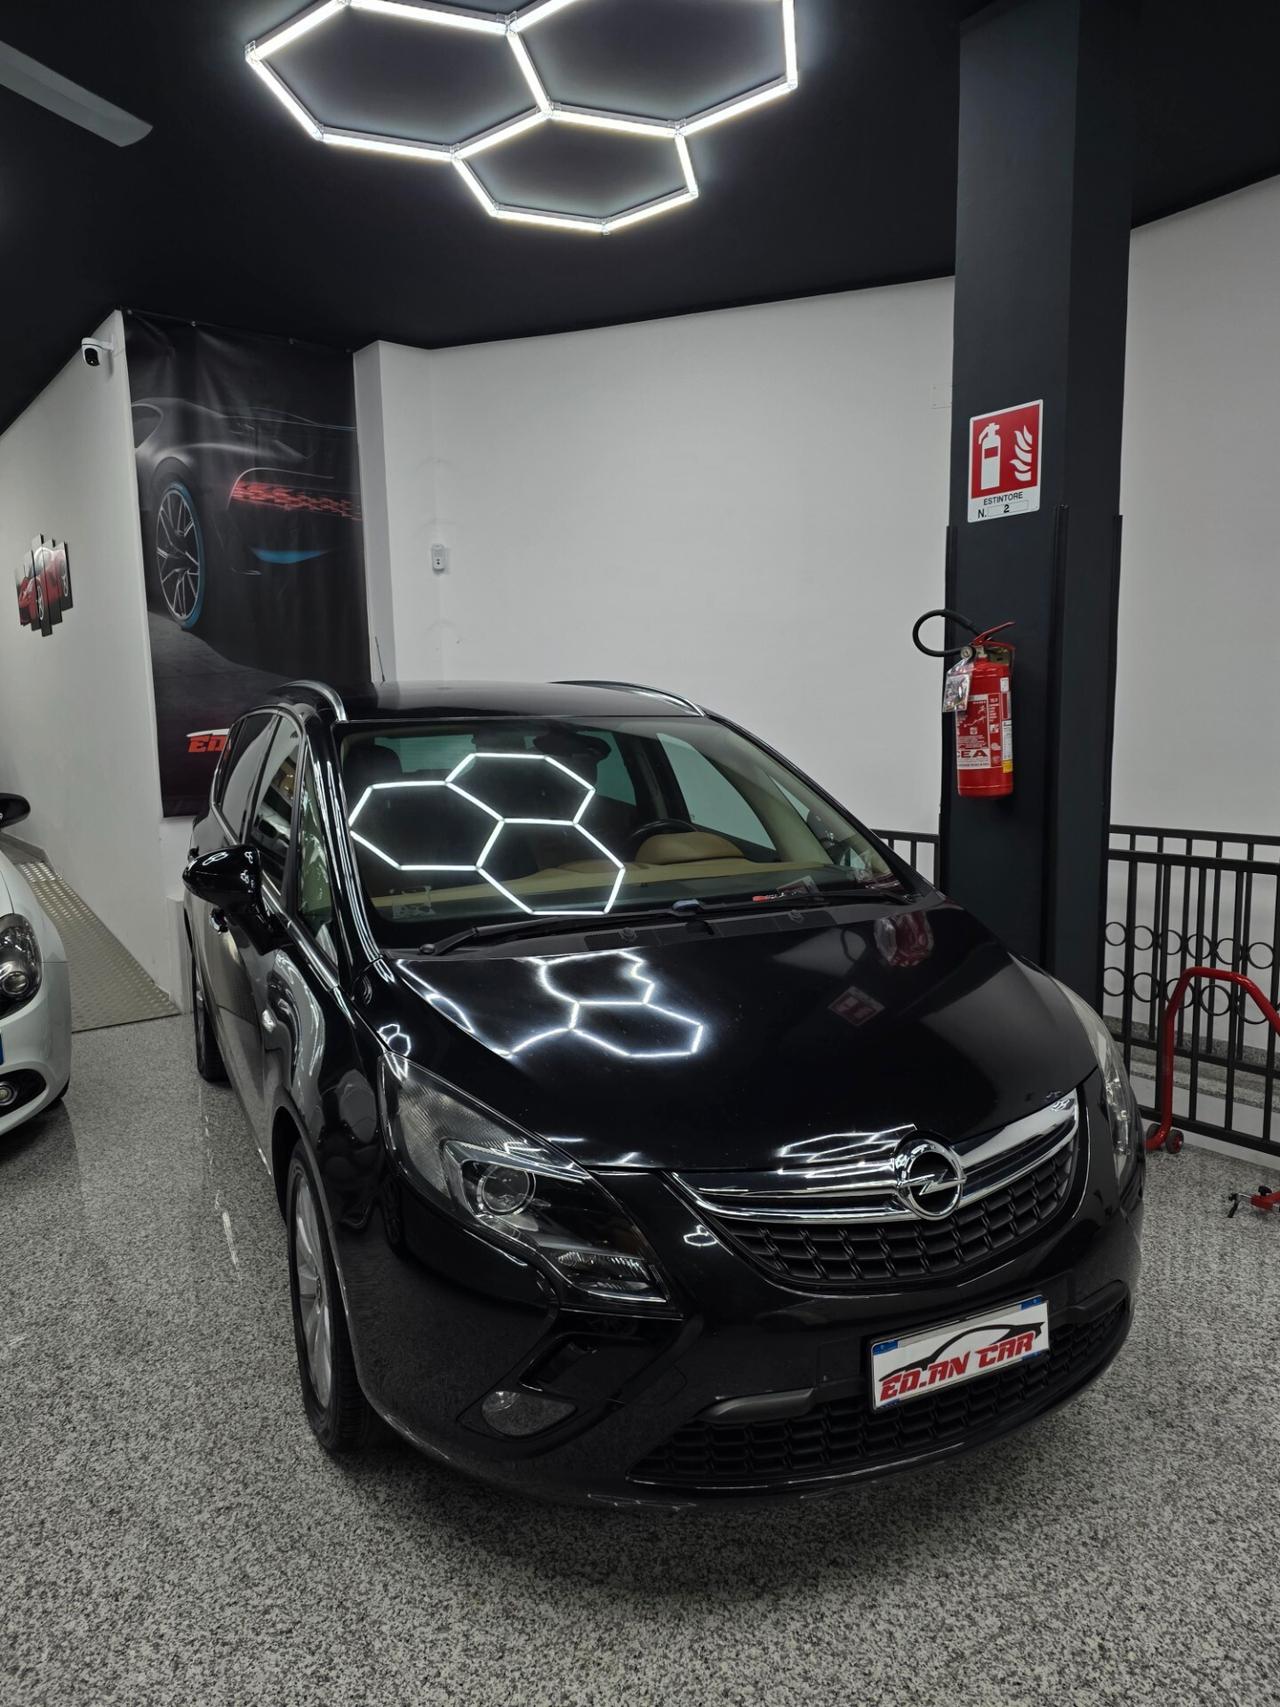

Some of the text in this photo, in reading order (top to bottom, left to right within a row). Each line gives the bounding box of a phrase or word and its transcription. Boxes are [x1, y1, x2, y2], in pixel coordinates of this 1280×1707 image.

[983, 492, 1023, 505] ESTINTORE
[978, 504, 1010, 518] N. 2
[957, 749, 988, 758] EA
[880, 1332, 1036, 1402] ED.AN CAR
